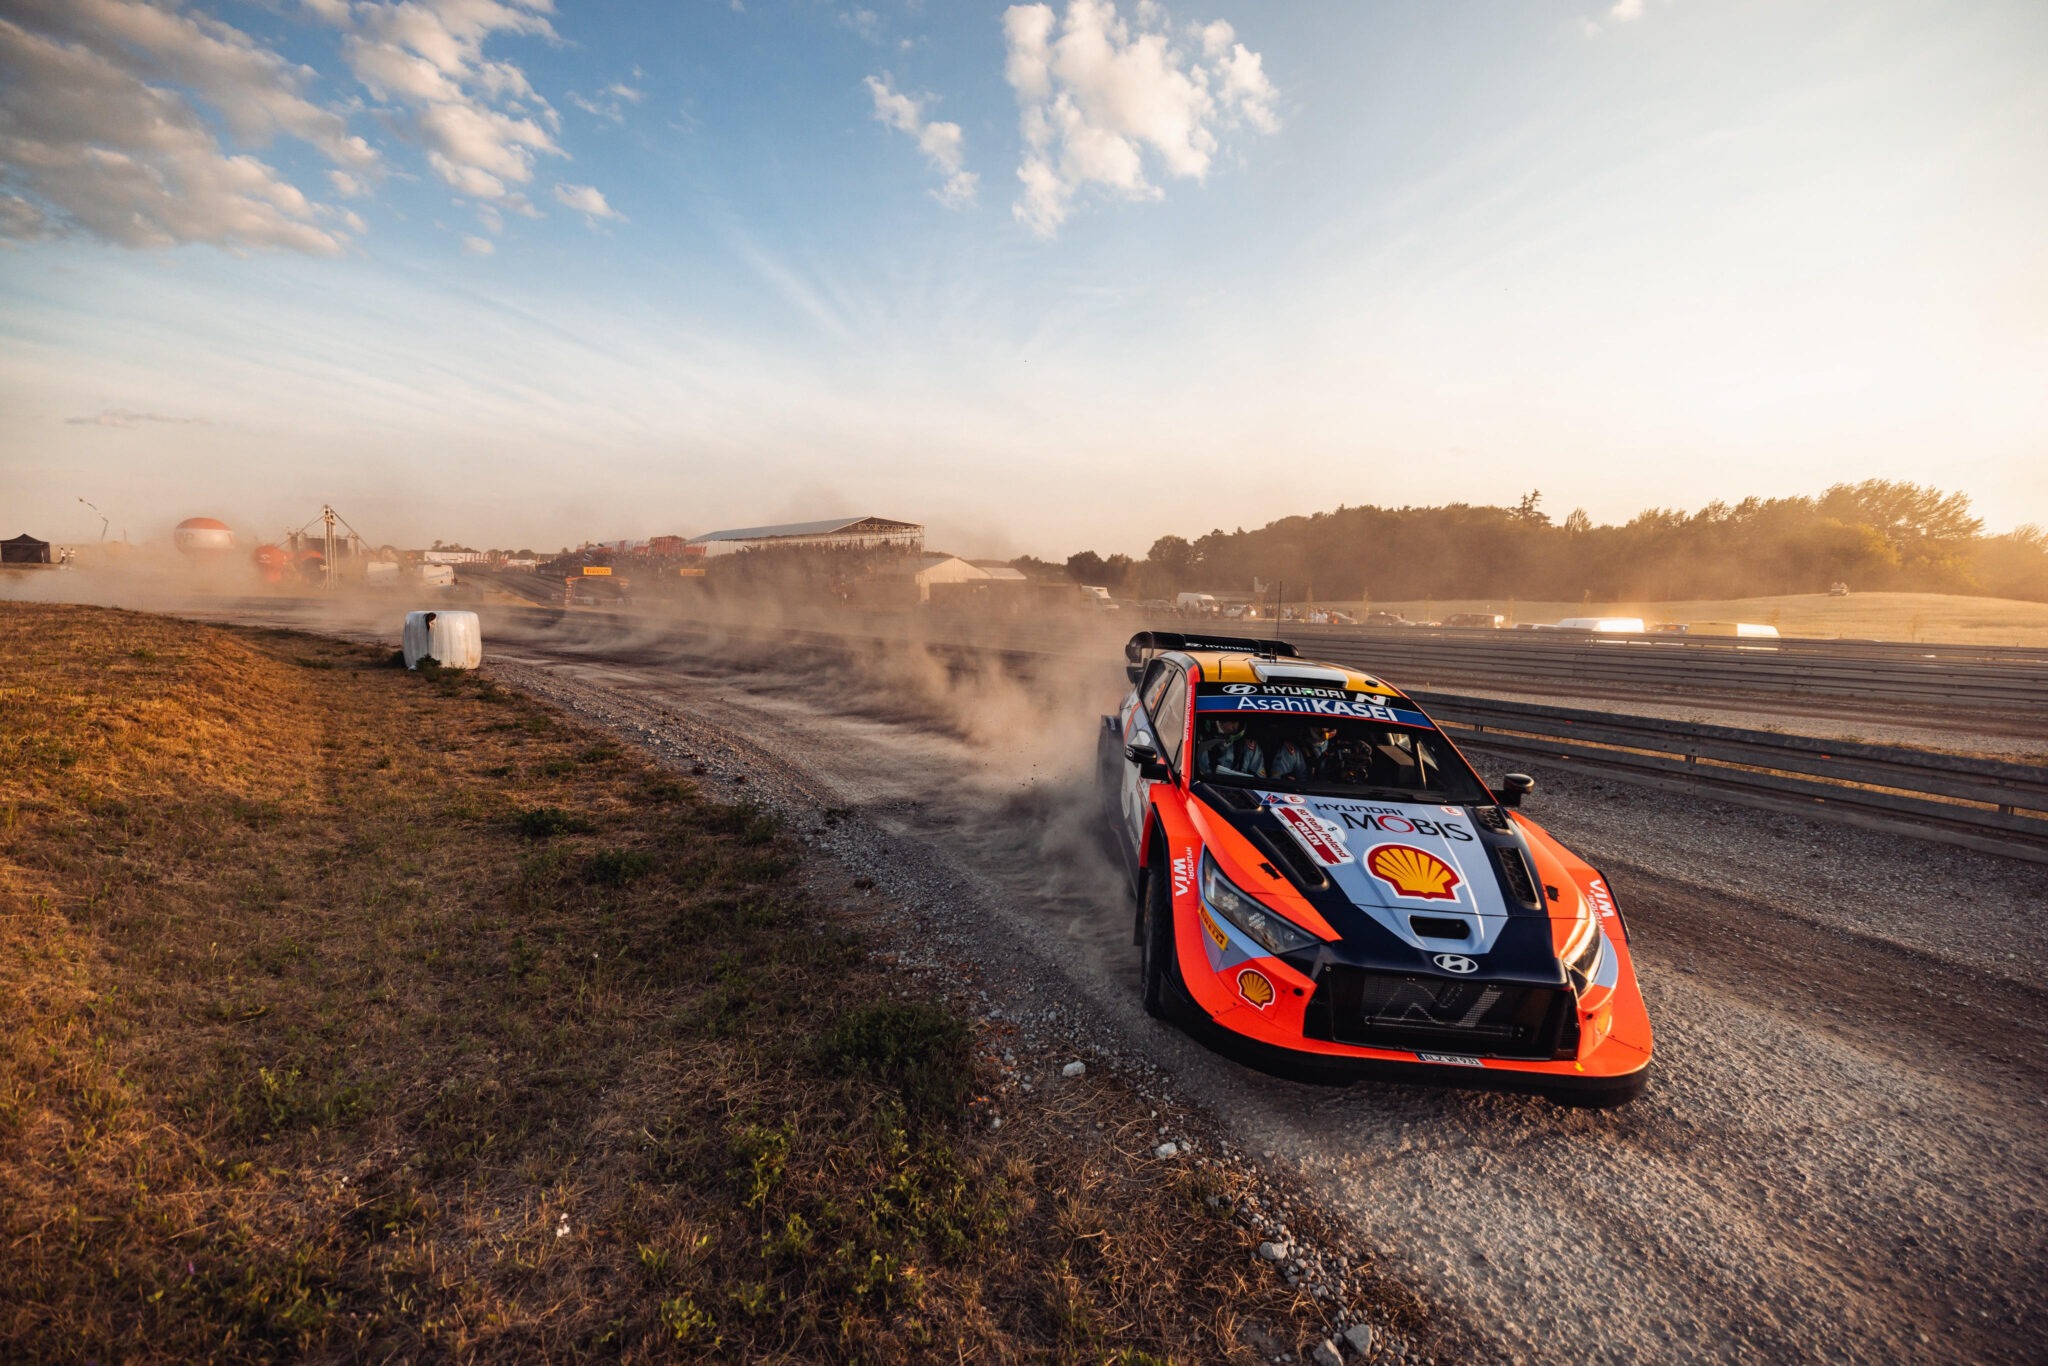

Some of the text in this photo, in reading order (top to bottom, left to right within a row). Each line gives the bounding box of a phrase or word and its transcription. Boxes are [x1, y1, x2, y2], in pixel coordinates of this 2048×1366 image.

[1263, 685, 1346, 699] HYUNDAI
[1314, 803, 1404, 816] HYUNDAI
[1294, 821, 1322, 846] ORLEN
[1305, 816, 1324, 832] Rally
[1320, 833, 1350, 858] Poland
[1338, 812, 1474, 842] MOBIS
[1186, 846, 1195, 879] HYUNDAI
[1587, 894, 1606, 931] HYUNDAI
